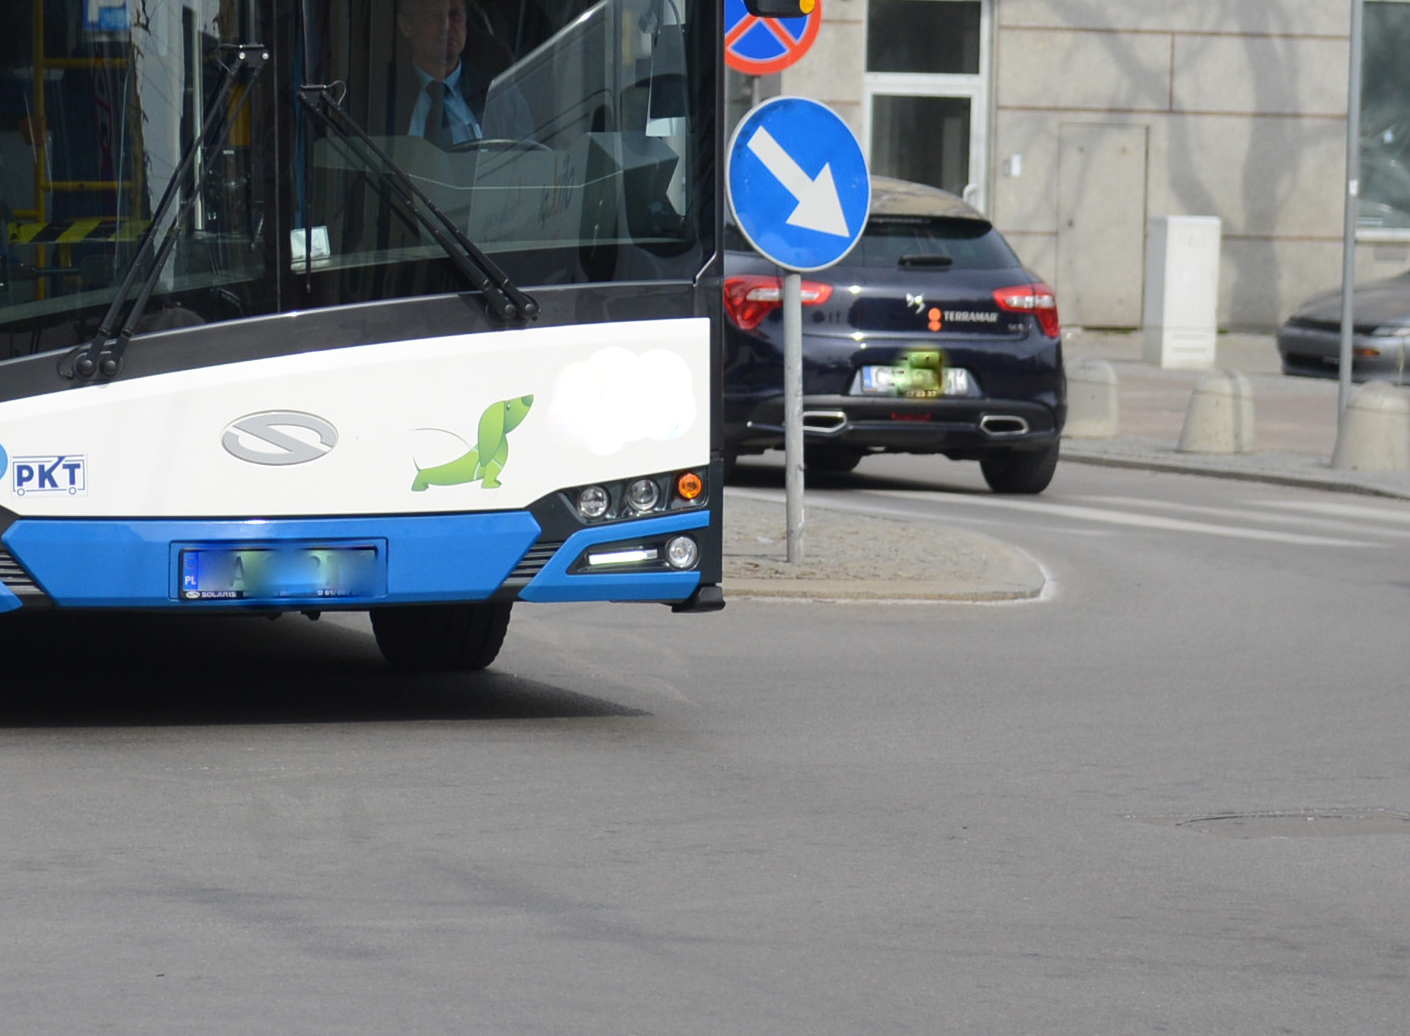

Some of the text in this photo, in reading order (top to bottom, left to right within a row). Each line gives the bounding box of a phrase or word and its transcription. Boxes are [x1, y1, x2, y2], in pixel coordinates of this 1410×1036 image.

[943, 310, 999, 323] TERRAMAR
[16, 456, 81, 488] PKT
[184, 575, 197, 586] PL
